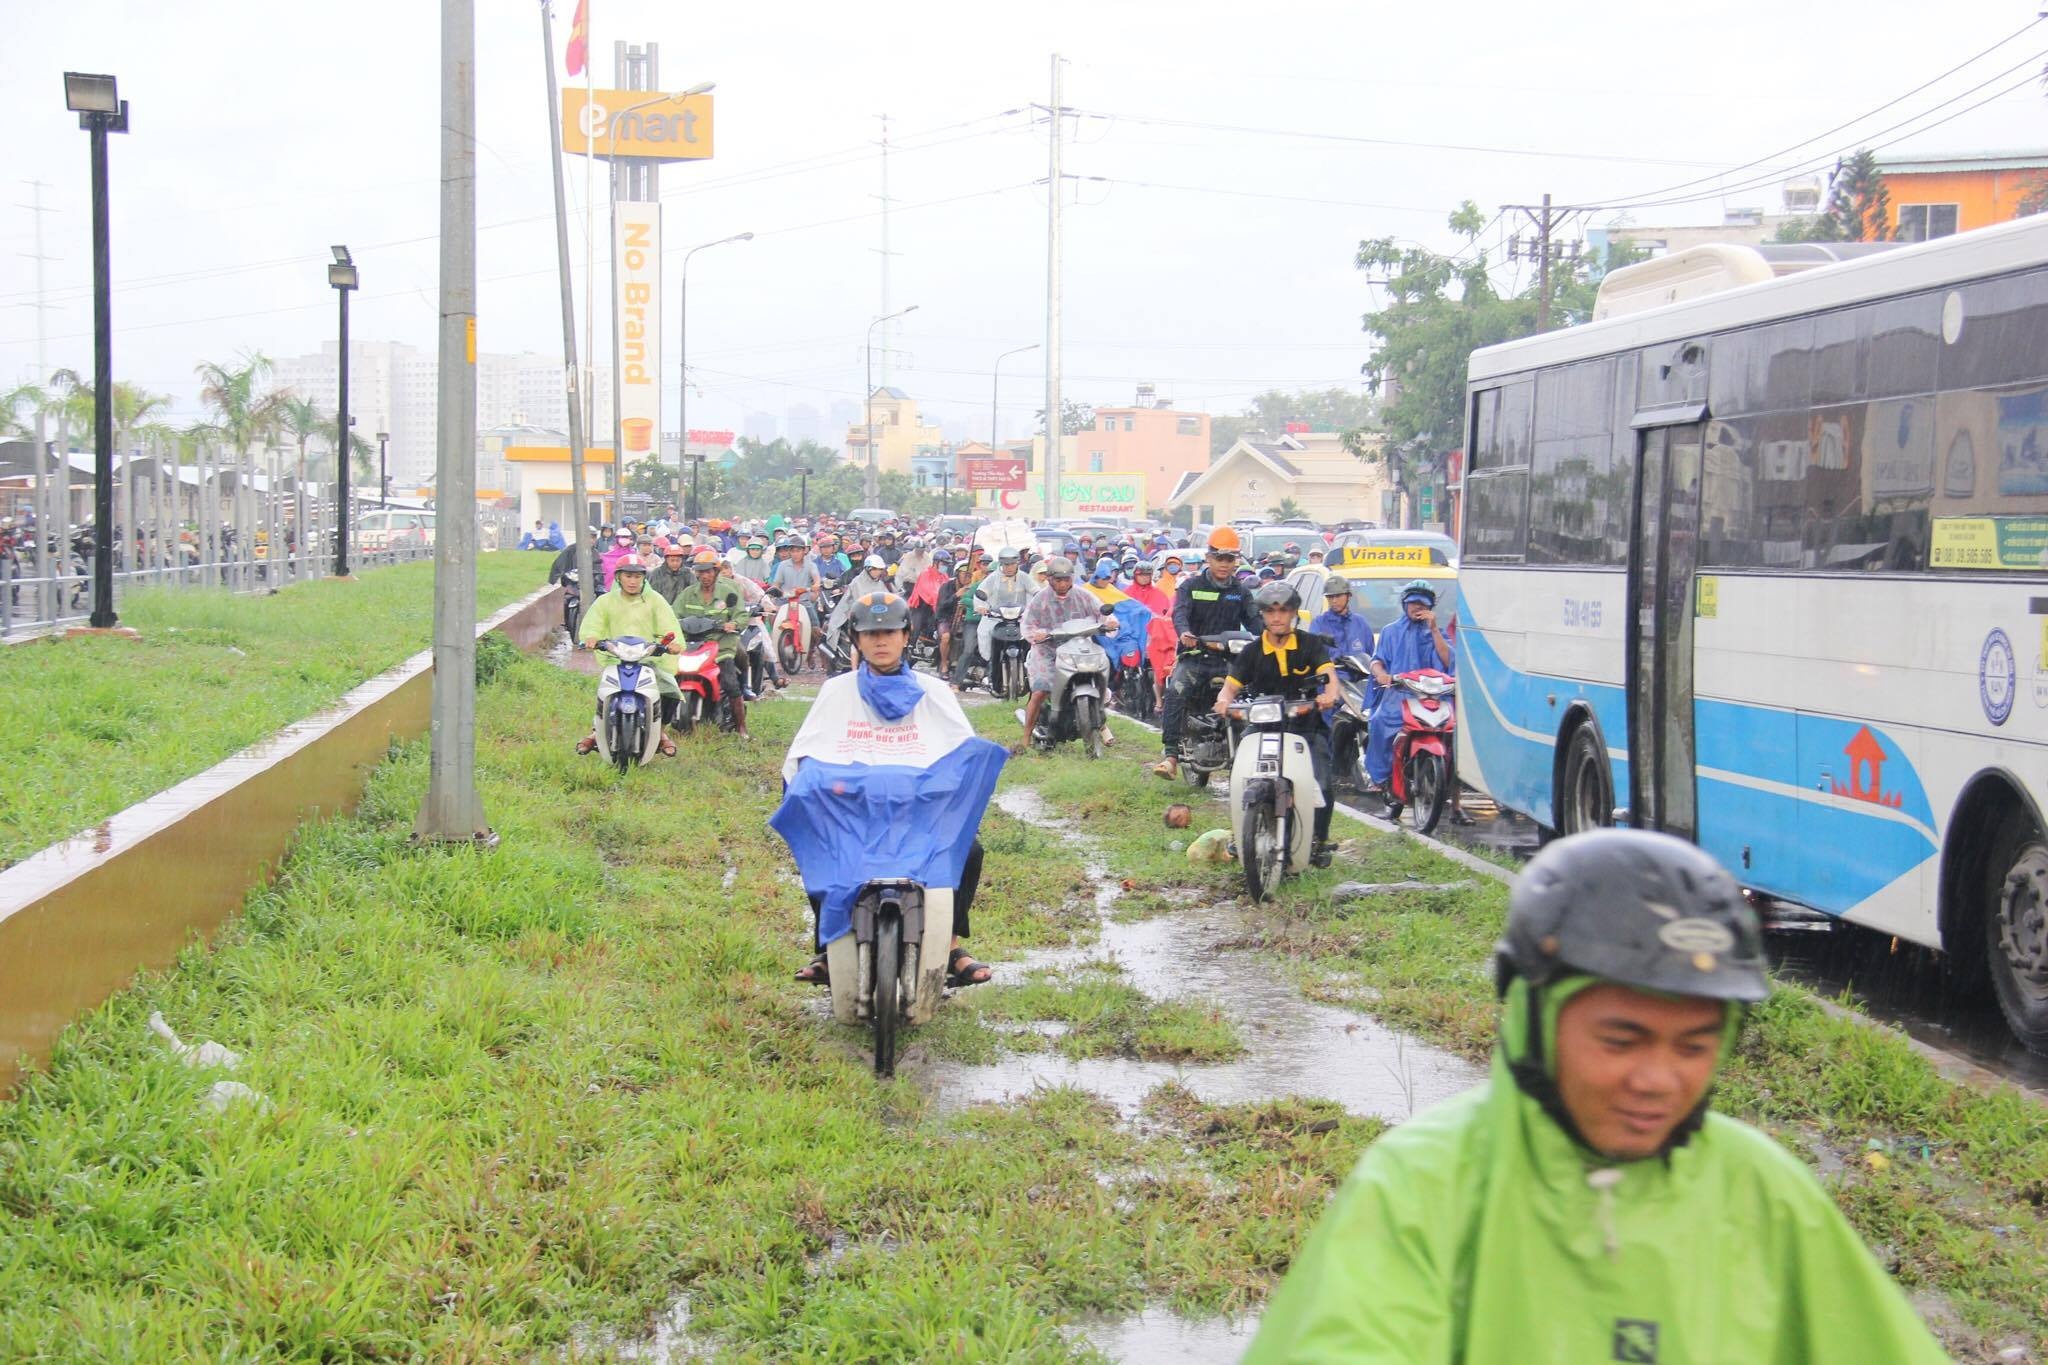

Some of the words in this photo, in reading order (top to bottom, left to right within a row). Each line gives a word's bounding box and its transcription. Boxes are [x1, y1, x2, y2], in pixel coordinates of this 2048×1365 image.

[579, 103, 698, 143] emart
[624, 223, 651, 271] No
[624, 282, 652, 385] Brand
[1078, 504, 1134, 513] RESTAURANT
[1350, 549, 1423, 561] Vinataxi
